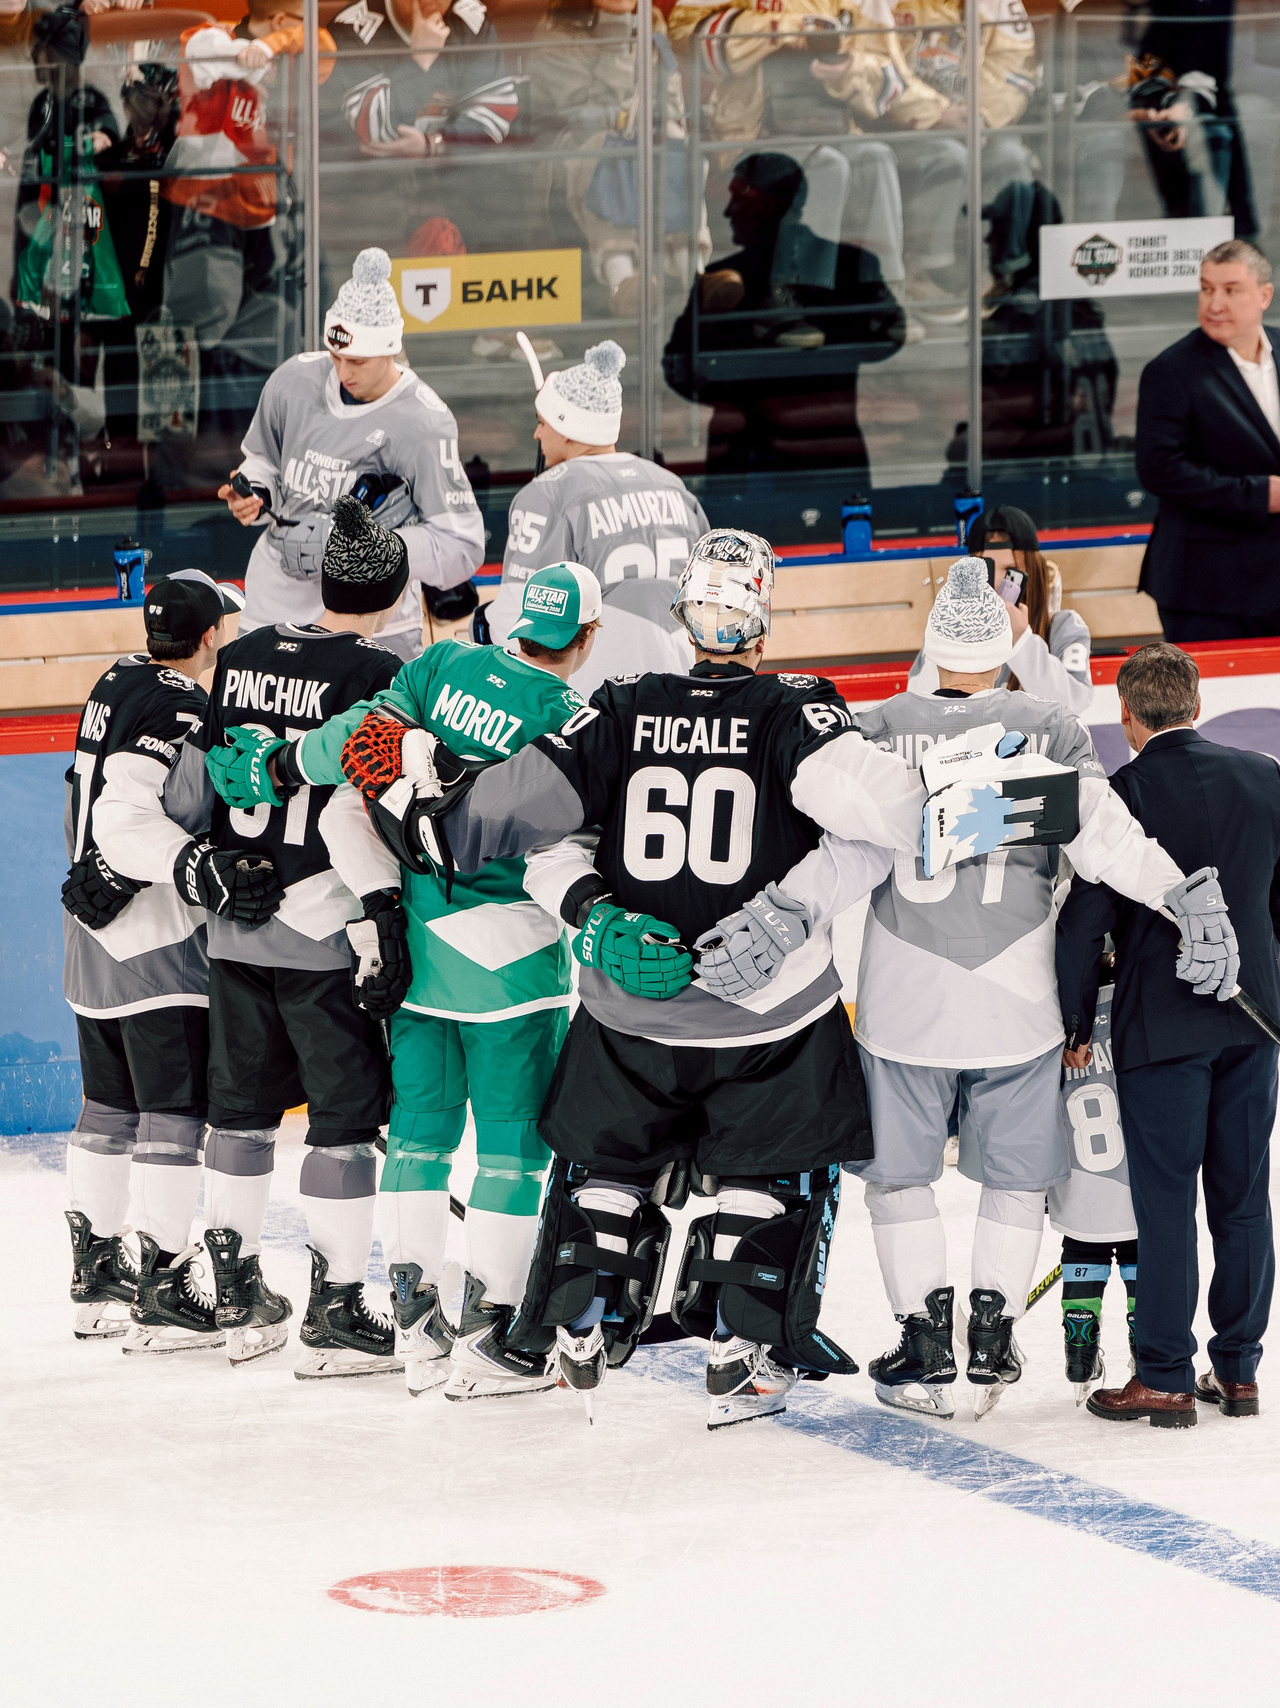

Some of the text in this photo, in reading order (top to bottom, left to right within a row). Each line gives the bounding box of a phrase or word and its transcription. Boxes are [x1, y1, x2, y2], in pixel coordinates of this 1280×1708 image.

[462, 276, 559, 304] БАНК
[438, 438, 467, 483] 4
[508, 509, 548, 555] 35
[587, 489, 689, 540] AIMURZIN
[222, 668, 331, 721] PINCHUK
[430, 683, 524, 756] MOROZ
[633, 714, 750, 755] FUCALE
[73, 749, 97, 864] 7
[623, 765, 757, 886] 60
[581, 906, 616, 963] SOYUZ
[1074, 1267, 1088, 1278] 87
[179, 1306, 207, 1323] BAUER
[355, 1327, 385, 1343] BAUER
[1066, 1312, 1093, 1321] BAUER
[503, 1352, 535, 1369] BAUER
